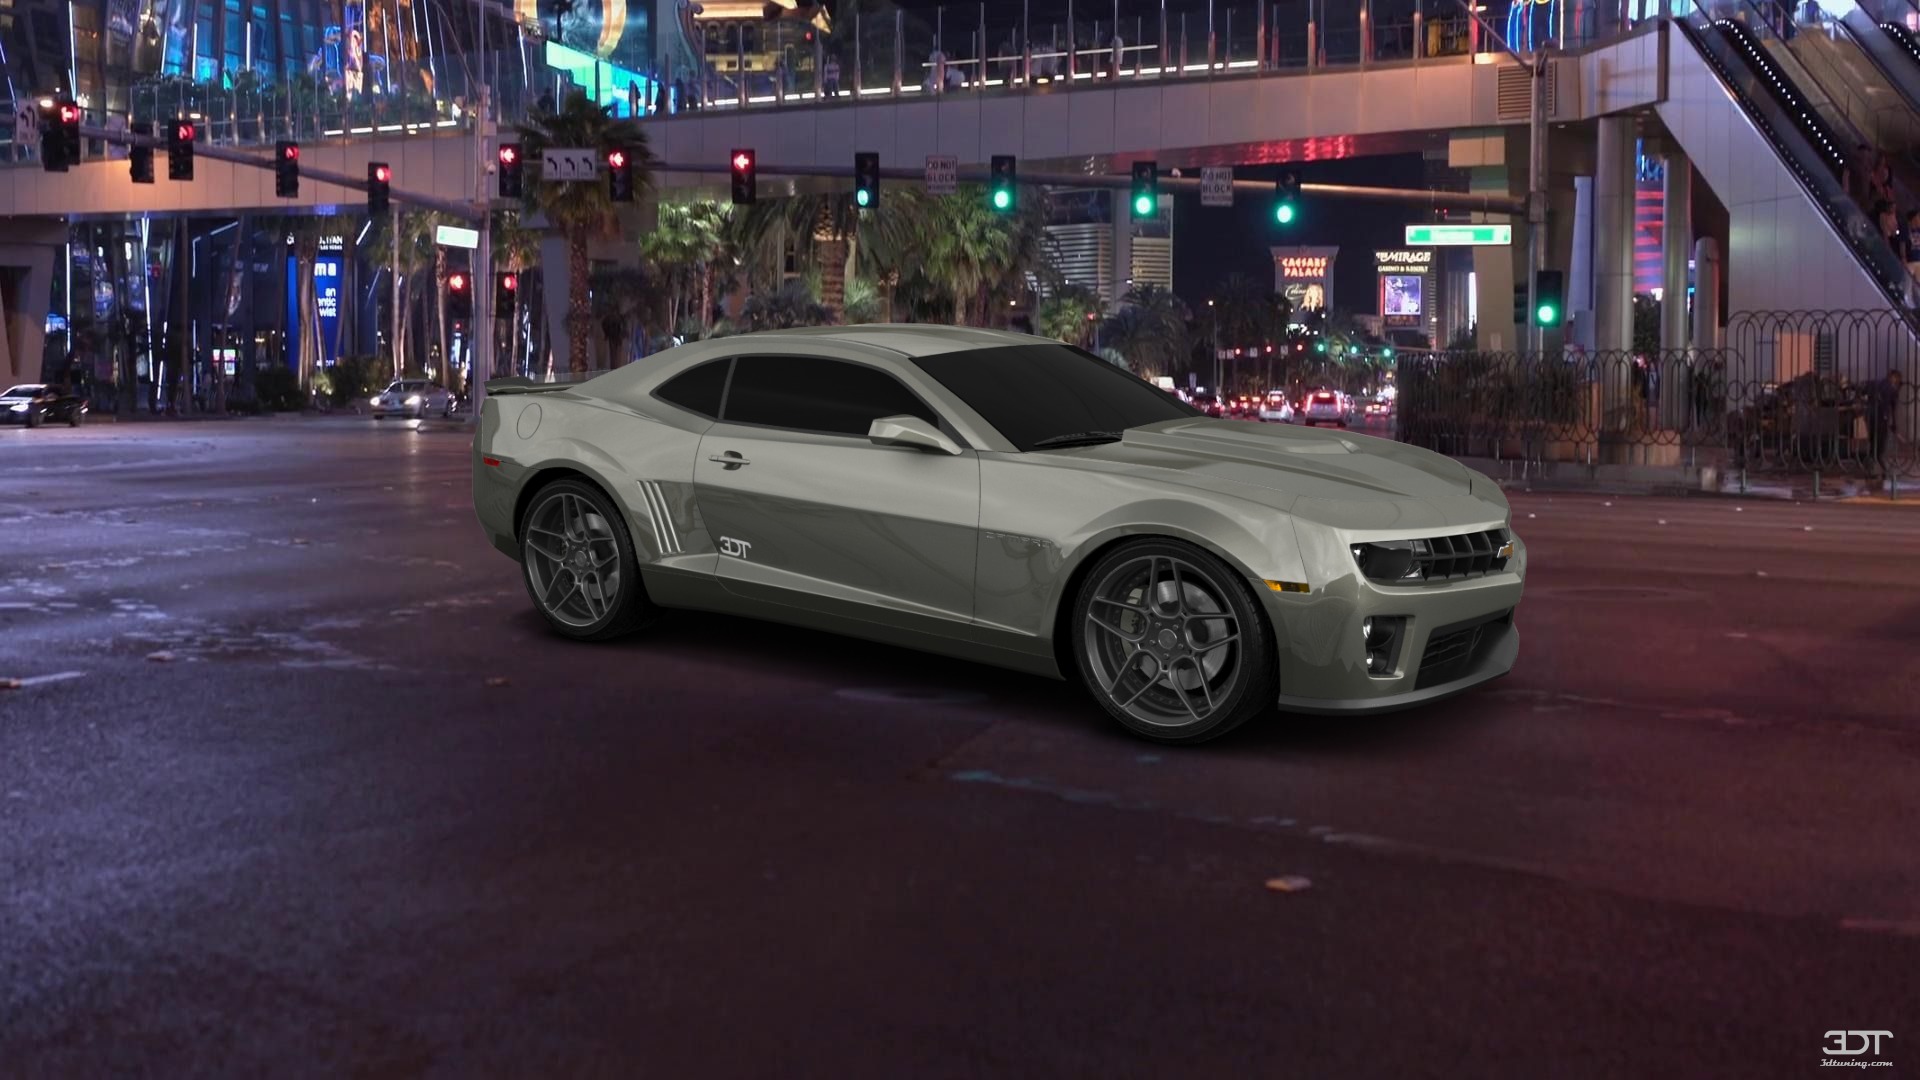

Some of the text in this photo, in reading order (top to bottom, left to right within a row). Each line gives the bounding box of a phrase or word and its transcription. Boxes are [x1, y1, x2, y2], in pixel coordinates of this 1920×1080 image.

[927, 174, 955, 182] BLOCK
[1202, 183, 1231, 192] BLOCK
[1387, 252, 1431, 263] MIRAGE
[1282, 258, 1326, 267] CAESARS
[1284, 267, 1324, 277] PALACE
[720, 536, 752, 559] 3DT
